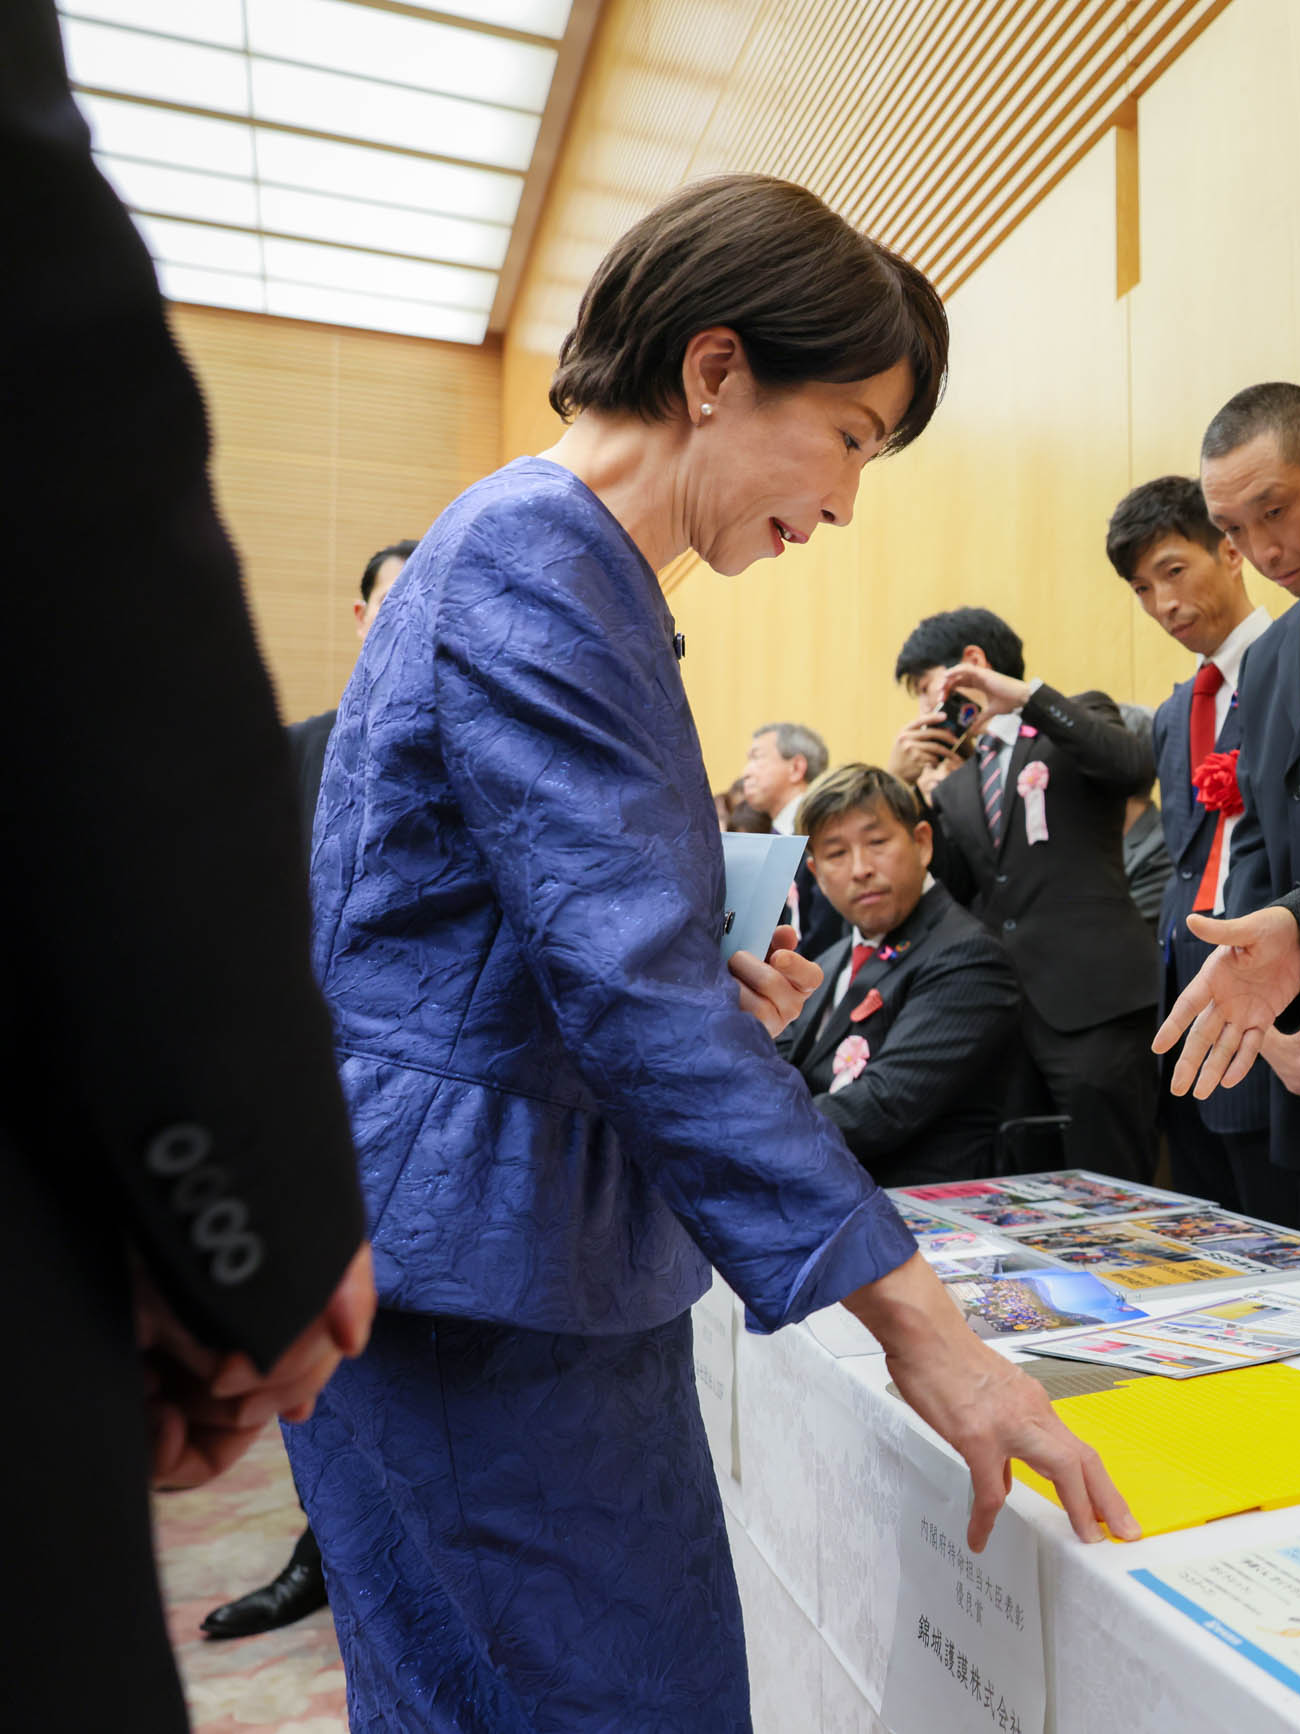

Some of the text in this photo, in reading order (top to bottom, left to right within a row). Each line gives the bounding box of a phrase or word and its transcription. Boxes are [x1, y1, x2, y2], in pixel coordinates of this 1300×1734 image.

[920, 1514, 1025, 1633] 内閣府特命担当大臣表彰
[955, 1579, 984, 1628] 優良賞
